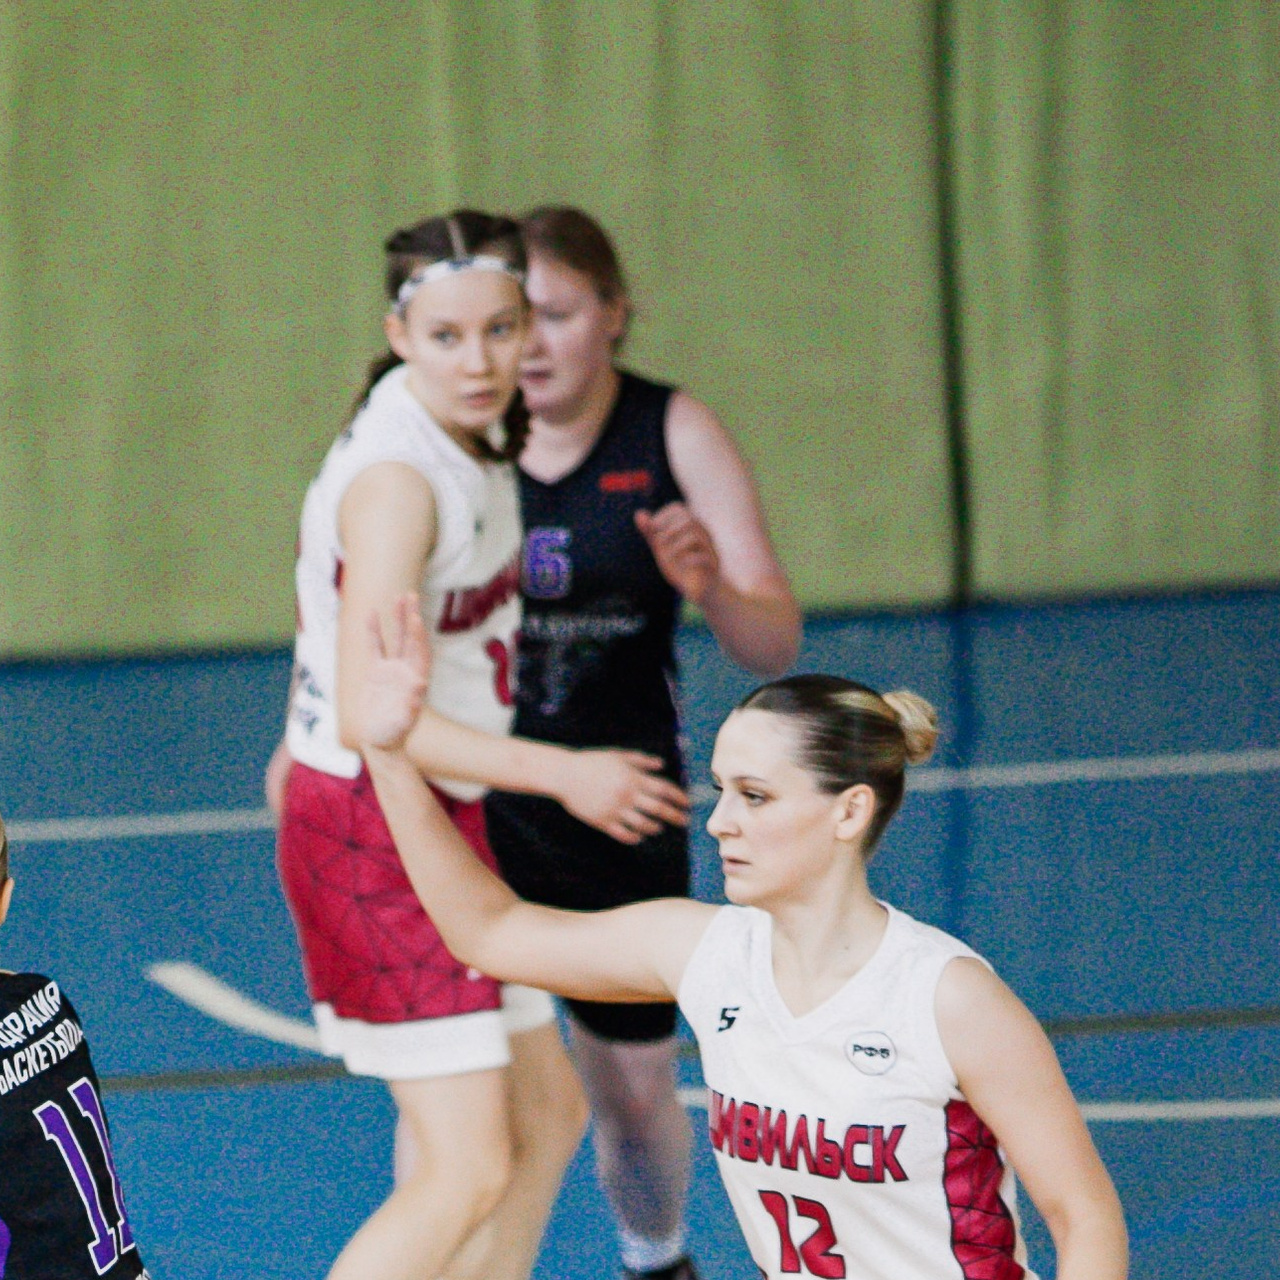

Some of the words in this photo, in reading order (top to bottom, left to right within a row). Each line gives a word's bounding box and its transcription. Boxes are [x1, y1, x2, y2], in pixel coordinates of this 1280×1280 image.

[32, 1076, 136, 1276] 11
[708, 1089, 910, 1184] ИВИЛЬСК
[757, 1189, 847, 1280] 12
